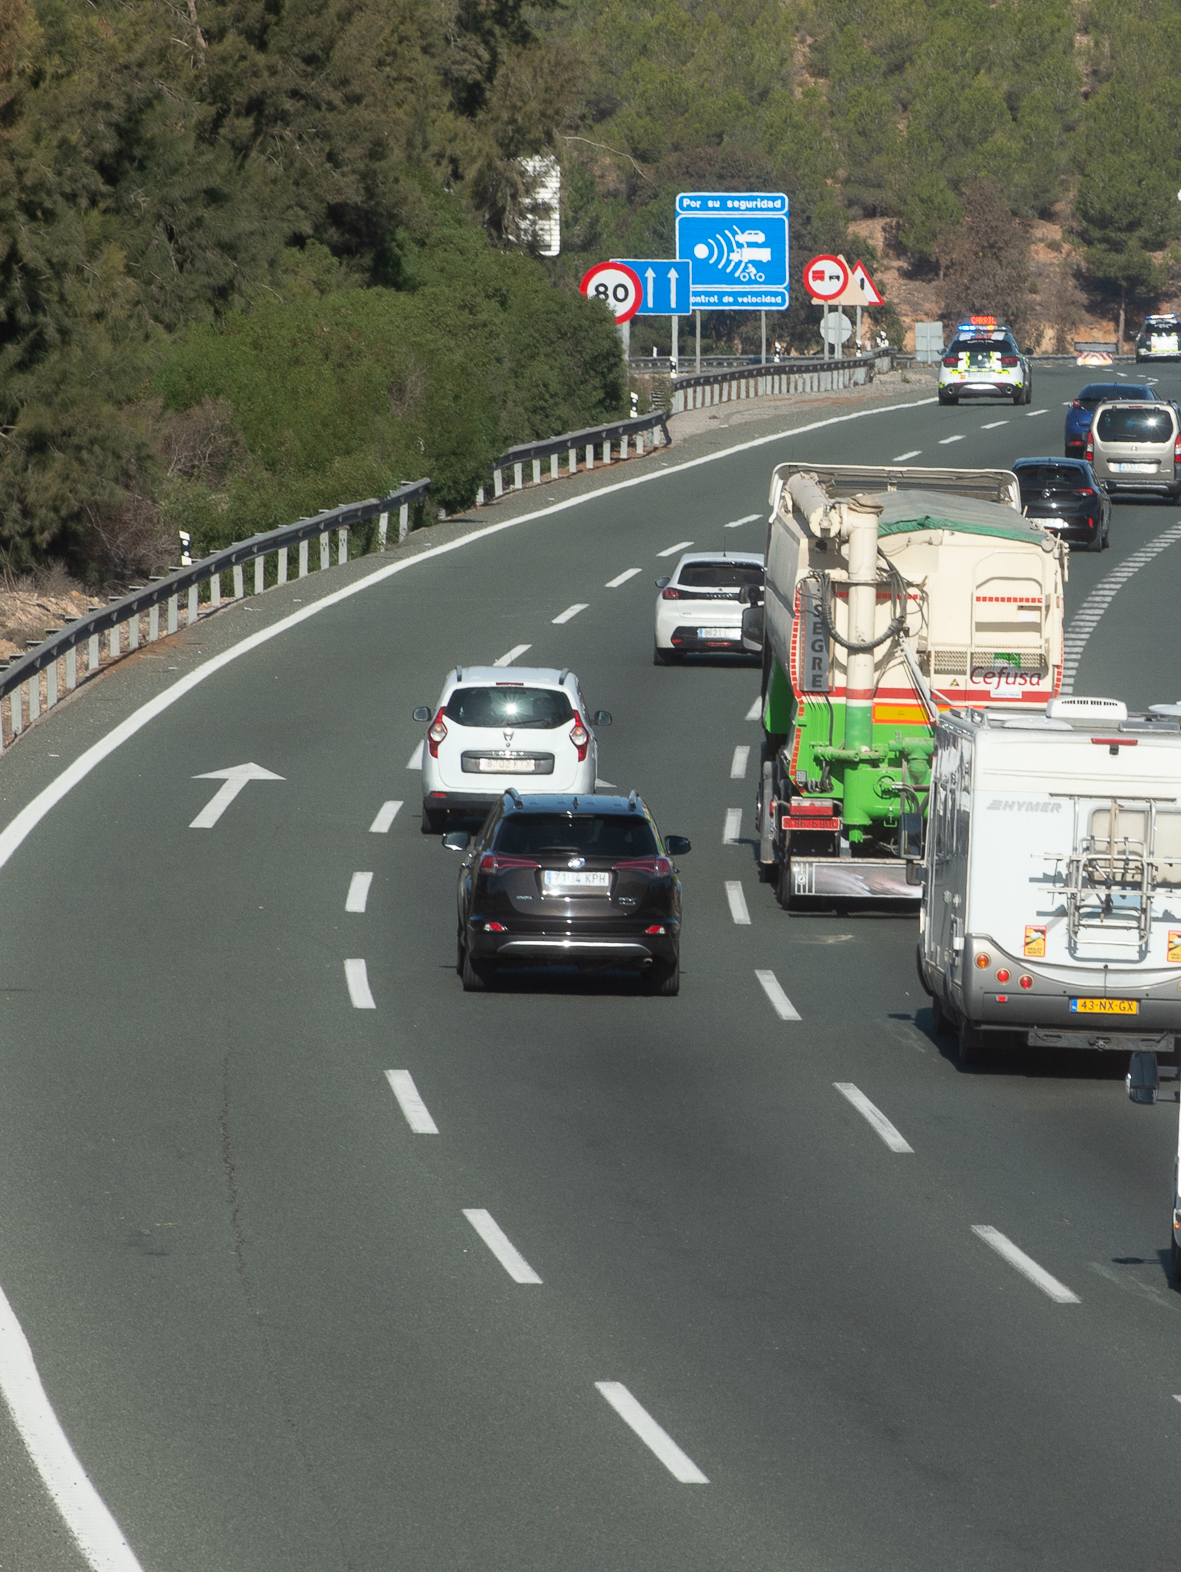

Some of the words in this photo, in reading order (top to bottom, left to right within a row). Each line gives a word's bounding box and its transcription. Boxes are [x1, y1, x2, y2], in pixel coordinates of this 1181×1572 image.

[682, 198, 701, 208] Por
[707, 199, 720, 208] su
[726, 198, 781, 210] seguridad
[594, 282, 629, 303] 80
[692, 295, 718, 303] ontrol
[722, 295, 734, 303] de
[737, 295, 782, 304] velocidad
[970, 666, 1042, 690] Cefusa
[1002, 800, 1063, 813] HYMER
[585, 873, 605, 883] KPH
[1081, 1000, 1133, 1012] 43-NX-GX
